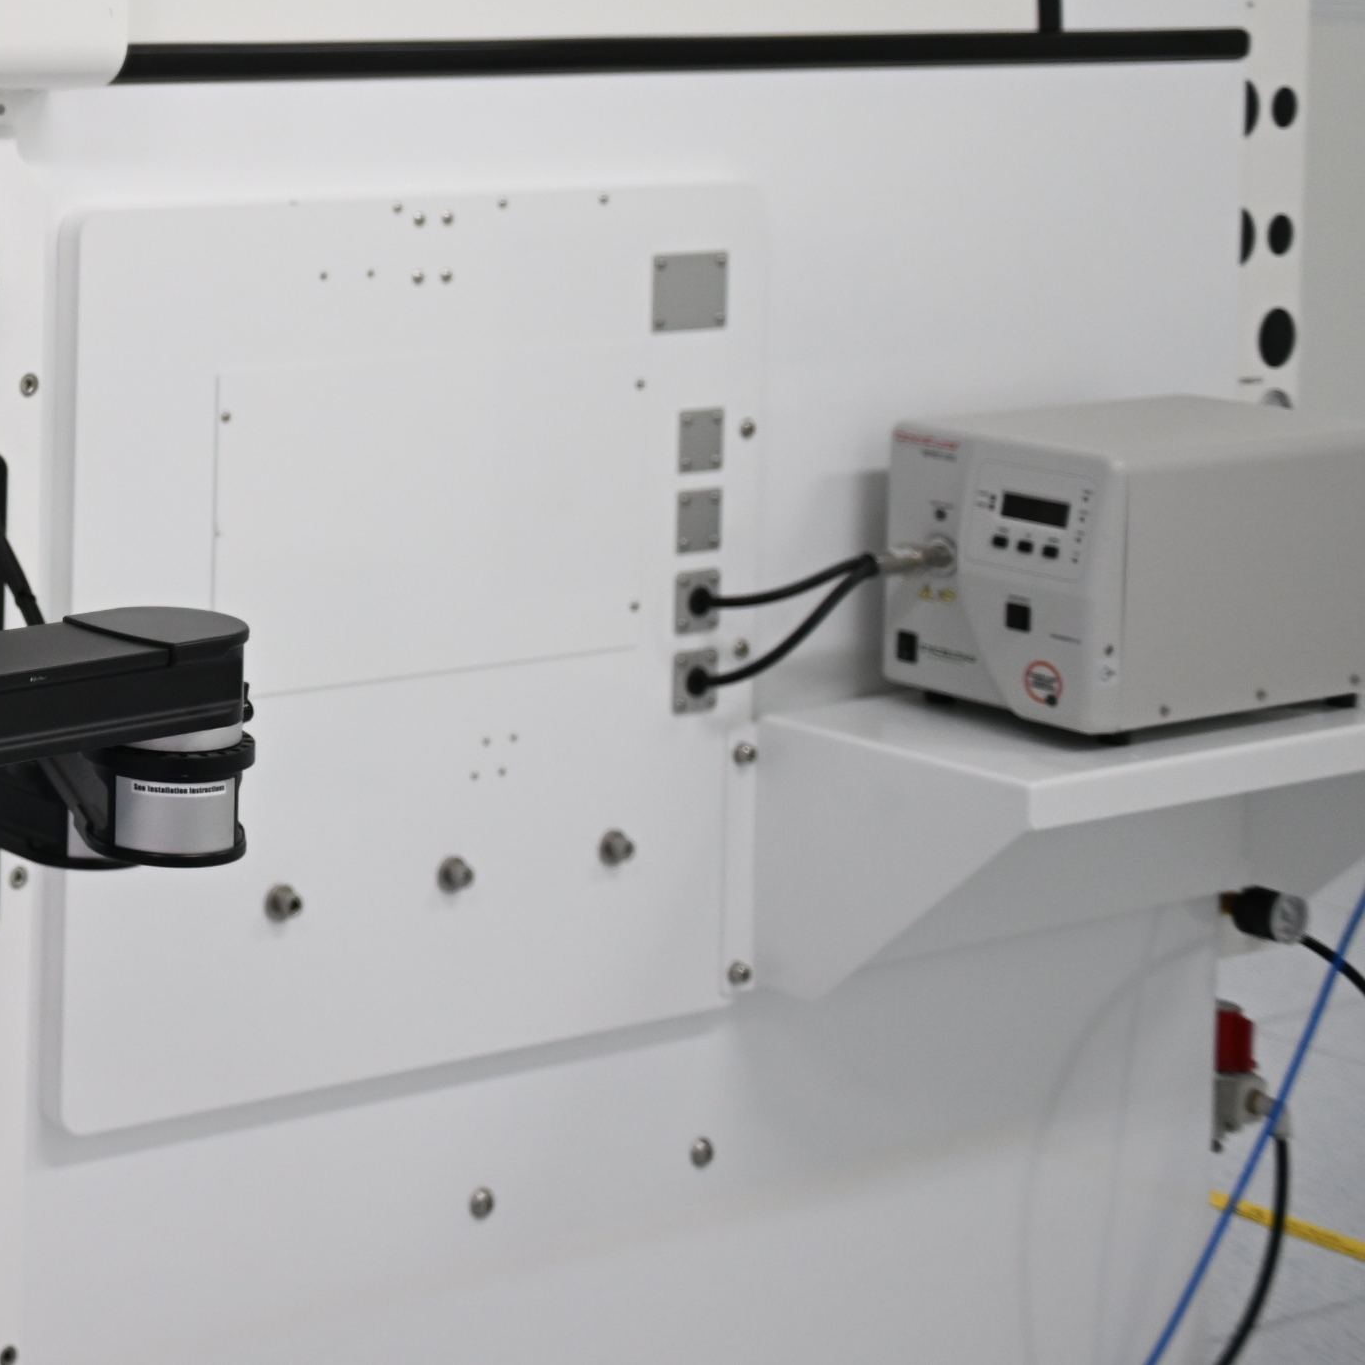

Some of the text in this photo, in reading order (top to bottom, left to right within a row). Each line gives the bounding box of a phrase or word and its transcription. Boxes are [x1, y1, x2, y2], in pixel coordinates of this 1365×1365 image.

[133, 783, 225, 795] See Installation Instructions
